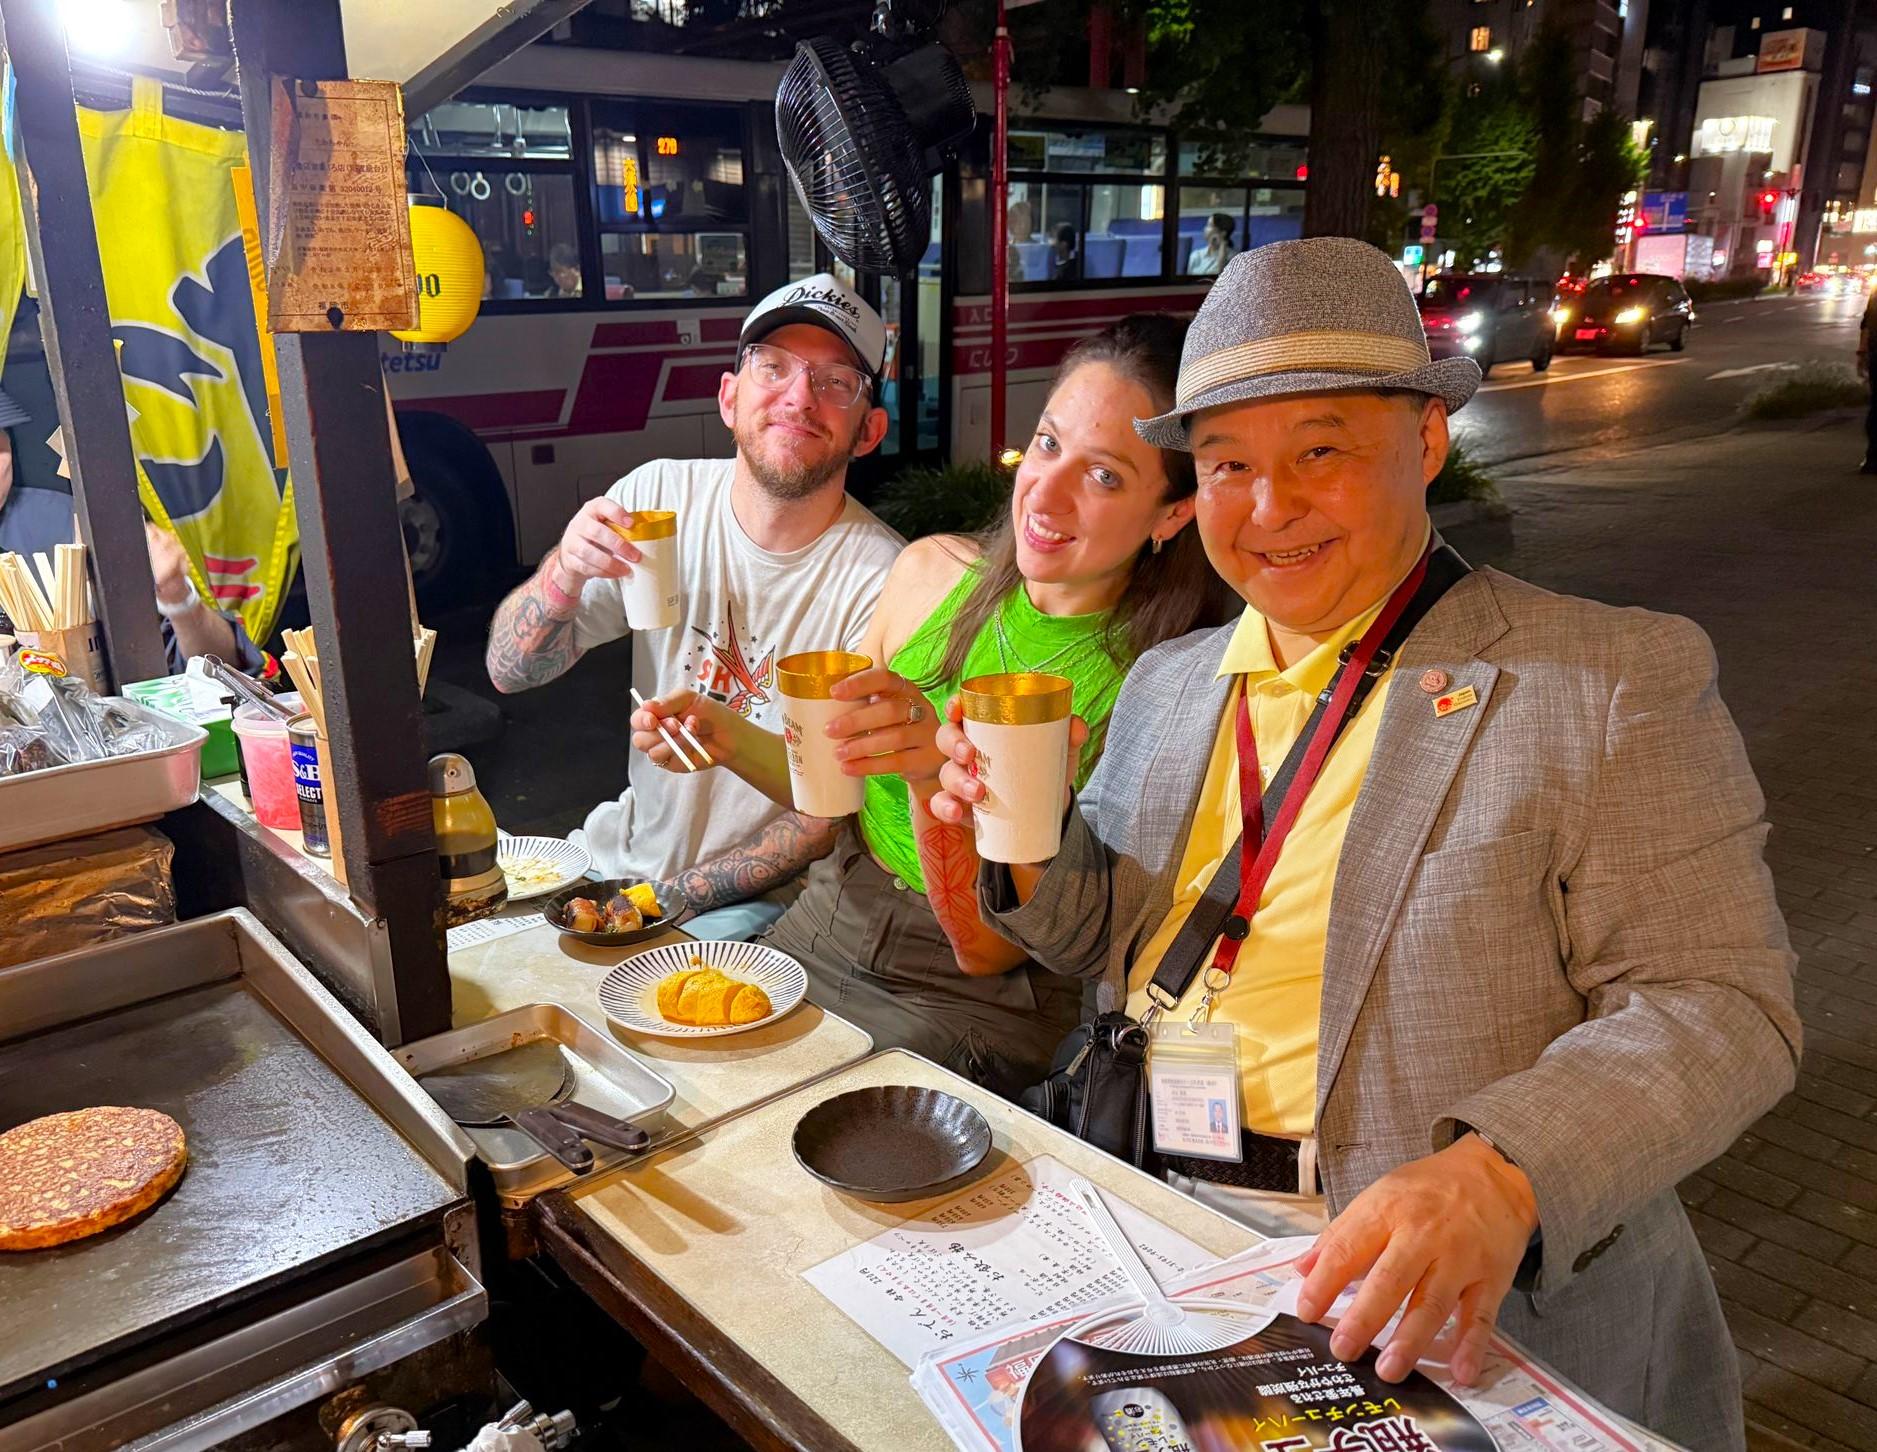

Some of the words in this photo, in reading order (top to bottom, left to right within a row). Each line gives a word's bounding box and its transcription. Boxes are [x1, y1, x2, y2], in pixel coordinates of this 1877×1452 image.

[780, 284, 861, 318] Dickies
[948, 1242, 1004, 1280] お飲み物
[1256, 1372, 1356, 1396] さわやかな強炭酸
[1296, 1362, 1346, 1377] チューハイ
[1290, 1384, 1366, 1405] 長年愛される
[1252, 1397, 1401, 1432] レモンチューハイ
